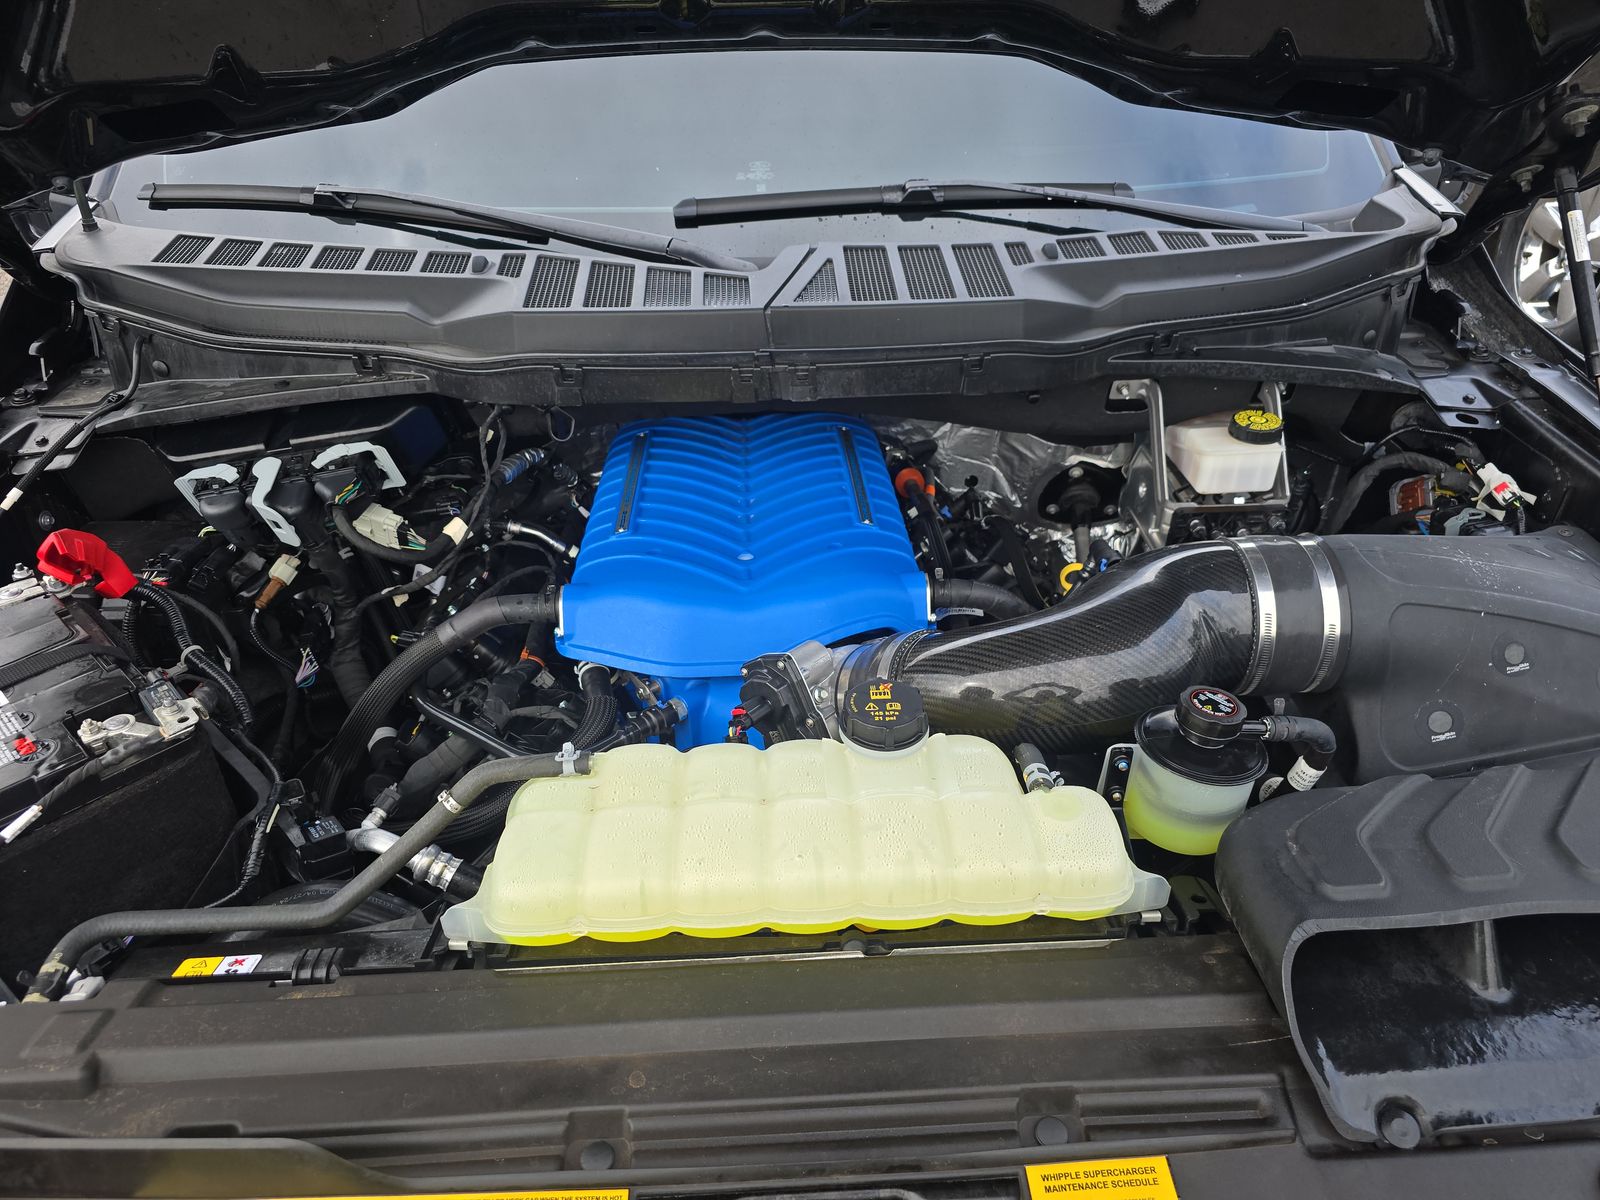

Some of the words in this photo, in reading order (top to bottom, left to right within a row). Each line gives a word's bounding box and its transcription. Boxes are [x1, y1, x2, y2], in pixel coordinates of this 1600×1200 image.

[1040, 1171, 1082, 1182] WHIPPLE
[1083, 1166, 1157, 1179] SUPERCHARGER
[1044, 1181, 1110, 1193] MAINTENANCE
[1111, 1177, 1160, 1188] SCHEDULE
